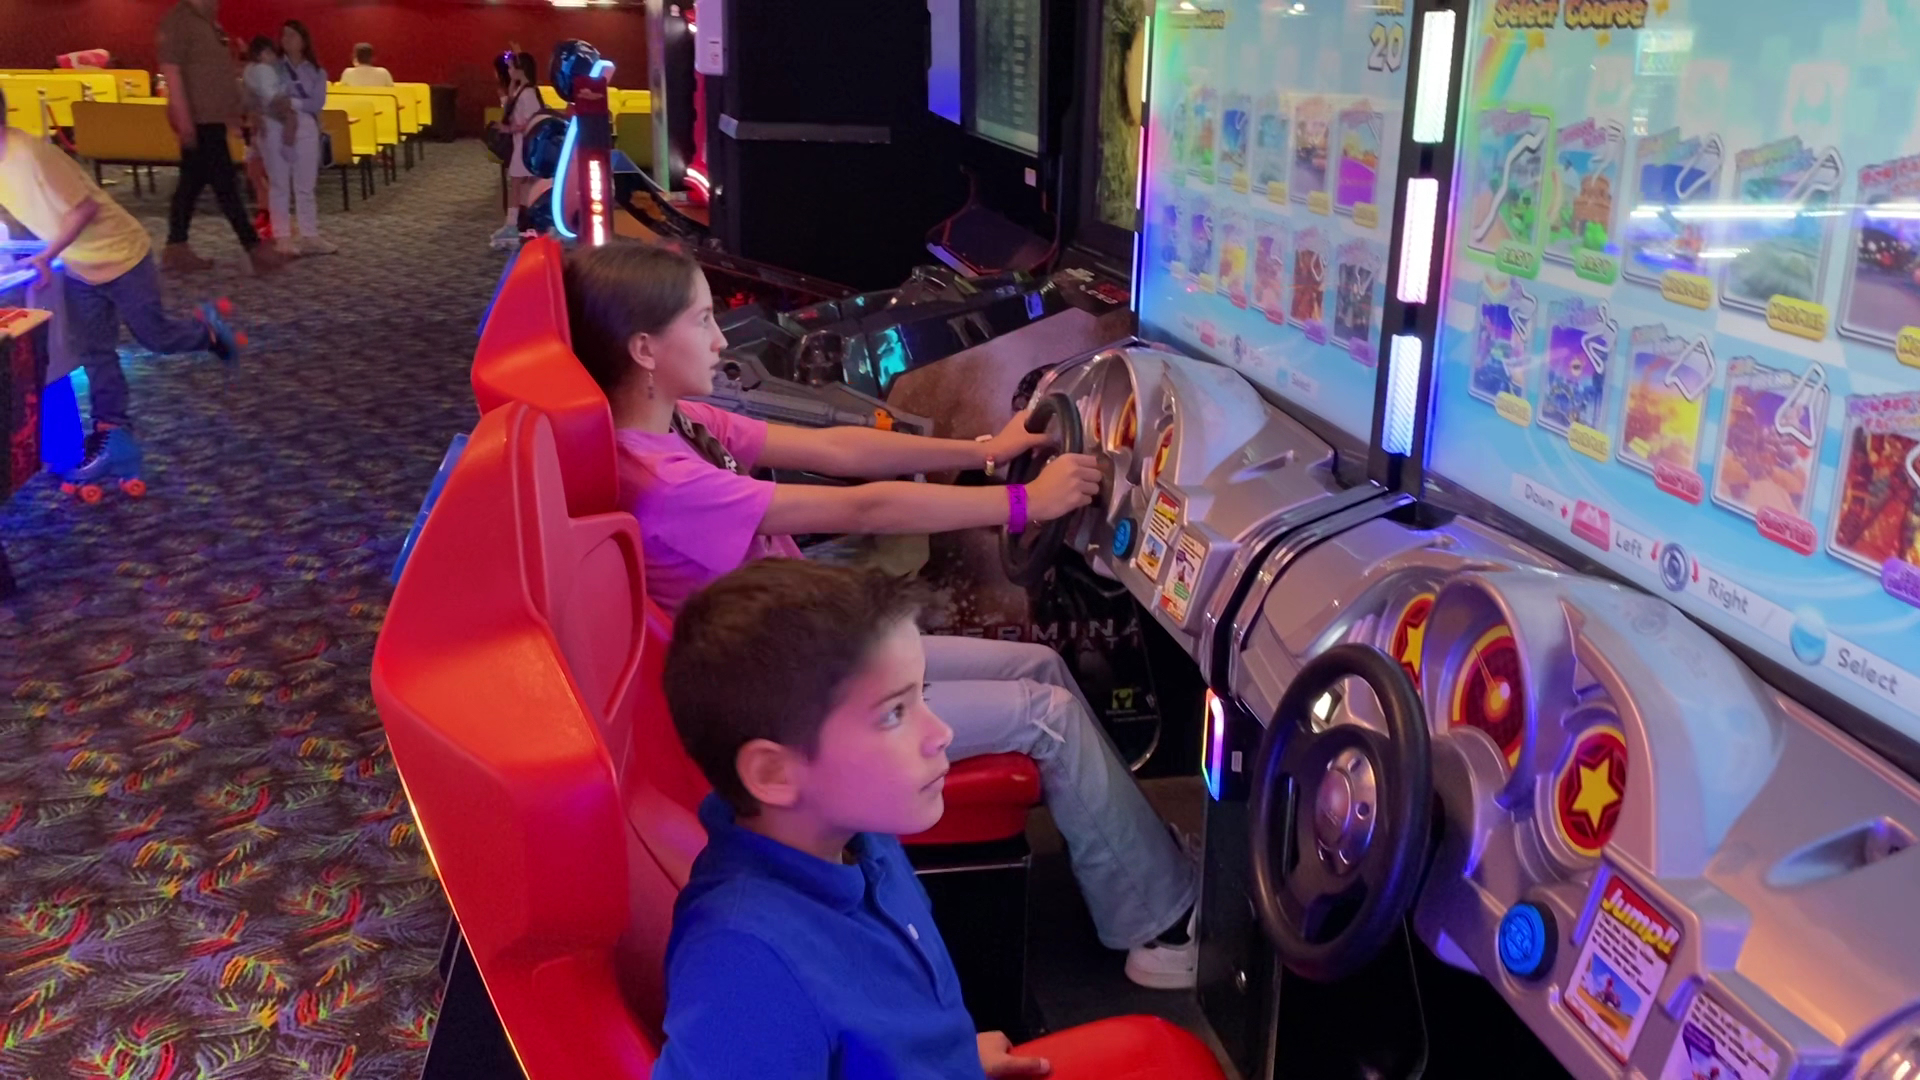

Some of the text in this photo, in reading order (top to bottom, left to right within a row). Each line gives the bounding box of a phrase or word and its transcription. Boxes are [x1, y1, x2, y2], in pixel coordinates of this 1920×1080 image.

[1367, 21, 1404, 73] 20
[1524, 483, 1898, 696] Down Left Right Select
